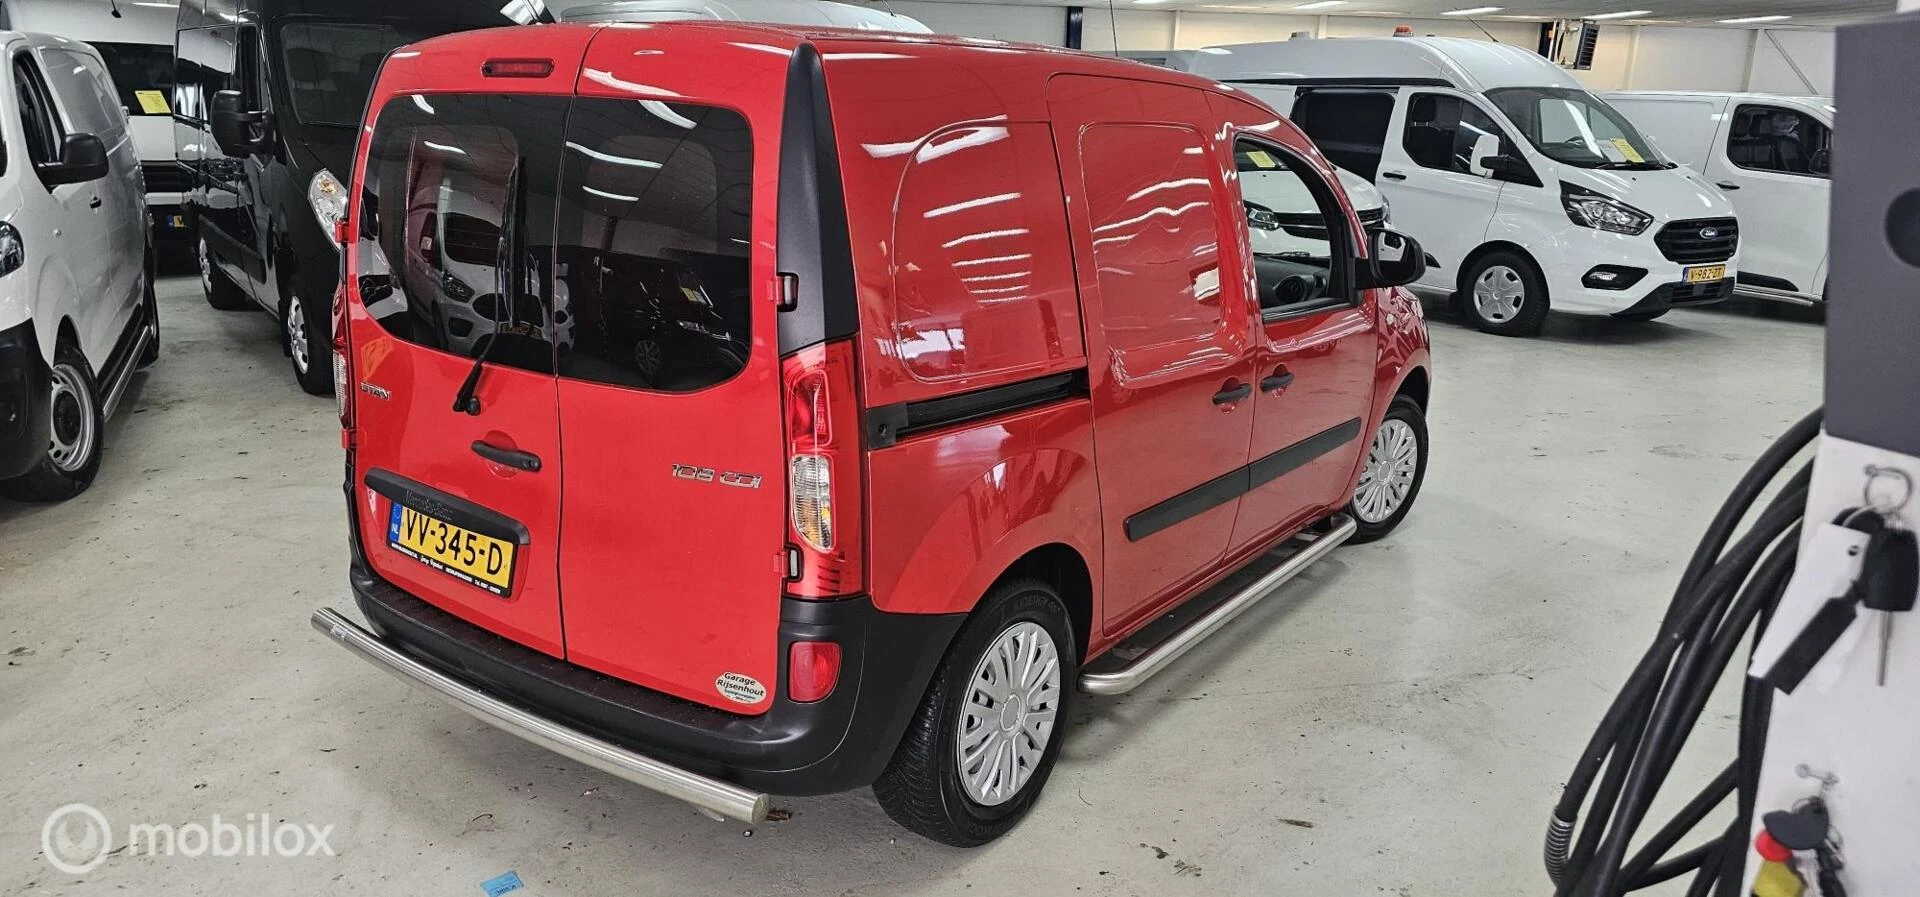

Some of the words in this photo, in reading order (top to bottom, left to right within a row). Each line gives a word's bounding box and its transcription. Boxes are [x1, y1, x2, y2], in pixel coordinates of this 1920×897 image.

[672, 463, 715, 482] 108
[719, 471, 762, 489] CDI
[406, 508, 503, 576] VV-345-D
[716, 678, 765, 697] Rijsenhout
[724, 672, 756, 686] Garage
